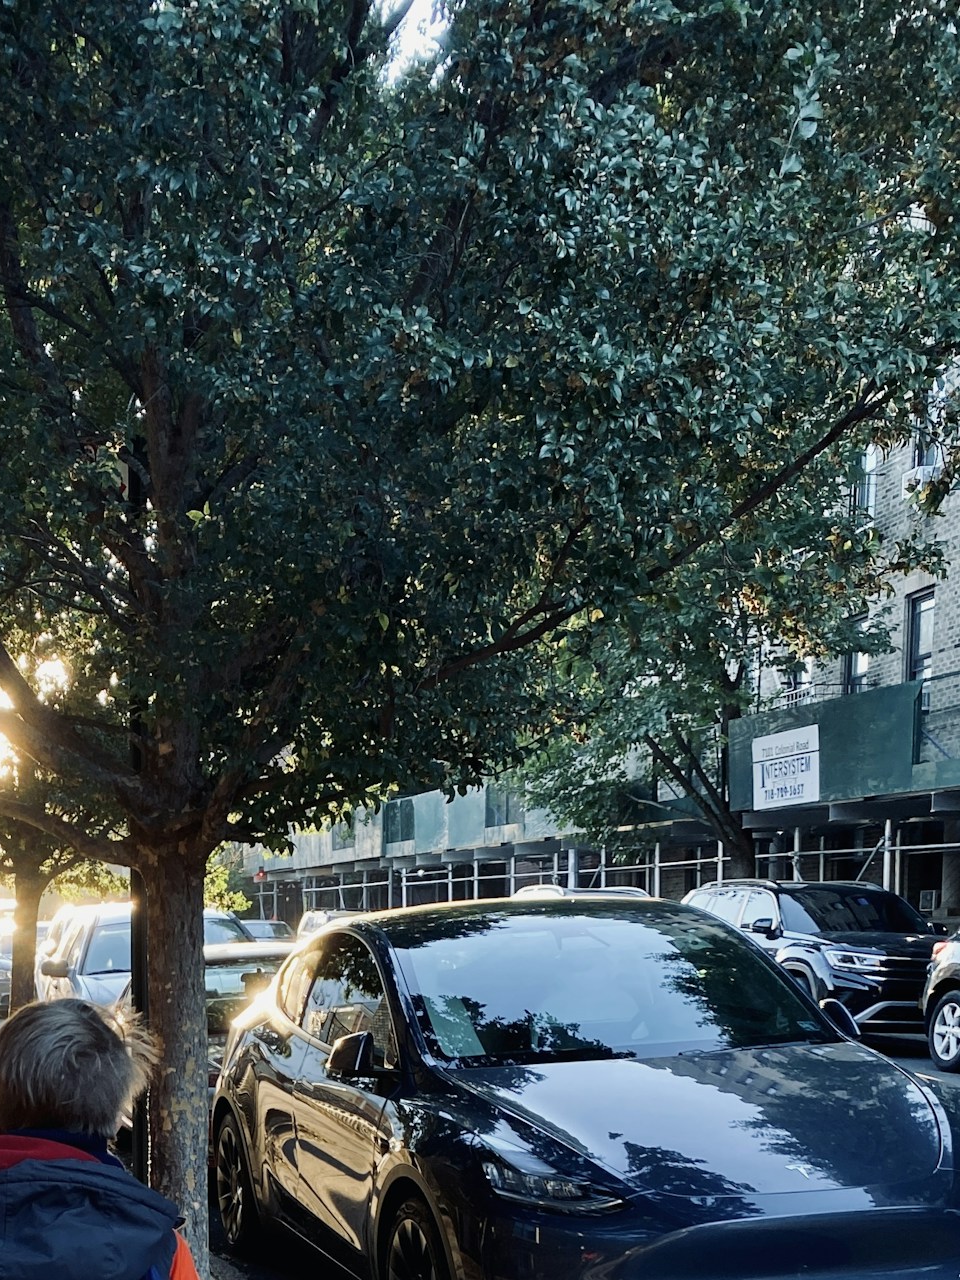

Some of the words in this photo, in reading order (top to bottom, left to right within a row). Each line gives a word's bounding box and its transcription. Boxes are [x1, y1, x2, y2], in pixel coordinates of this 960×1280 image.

[775, 742, 795, 755] Colonial
[796, 739, 809, 752] Road
[760, 755, 811, 789] INTERSYSTEM
